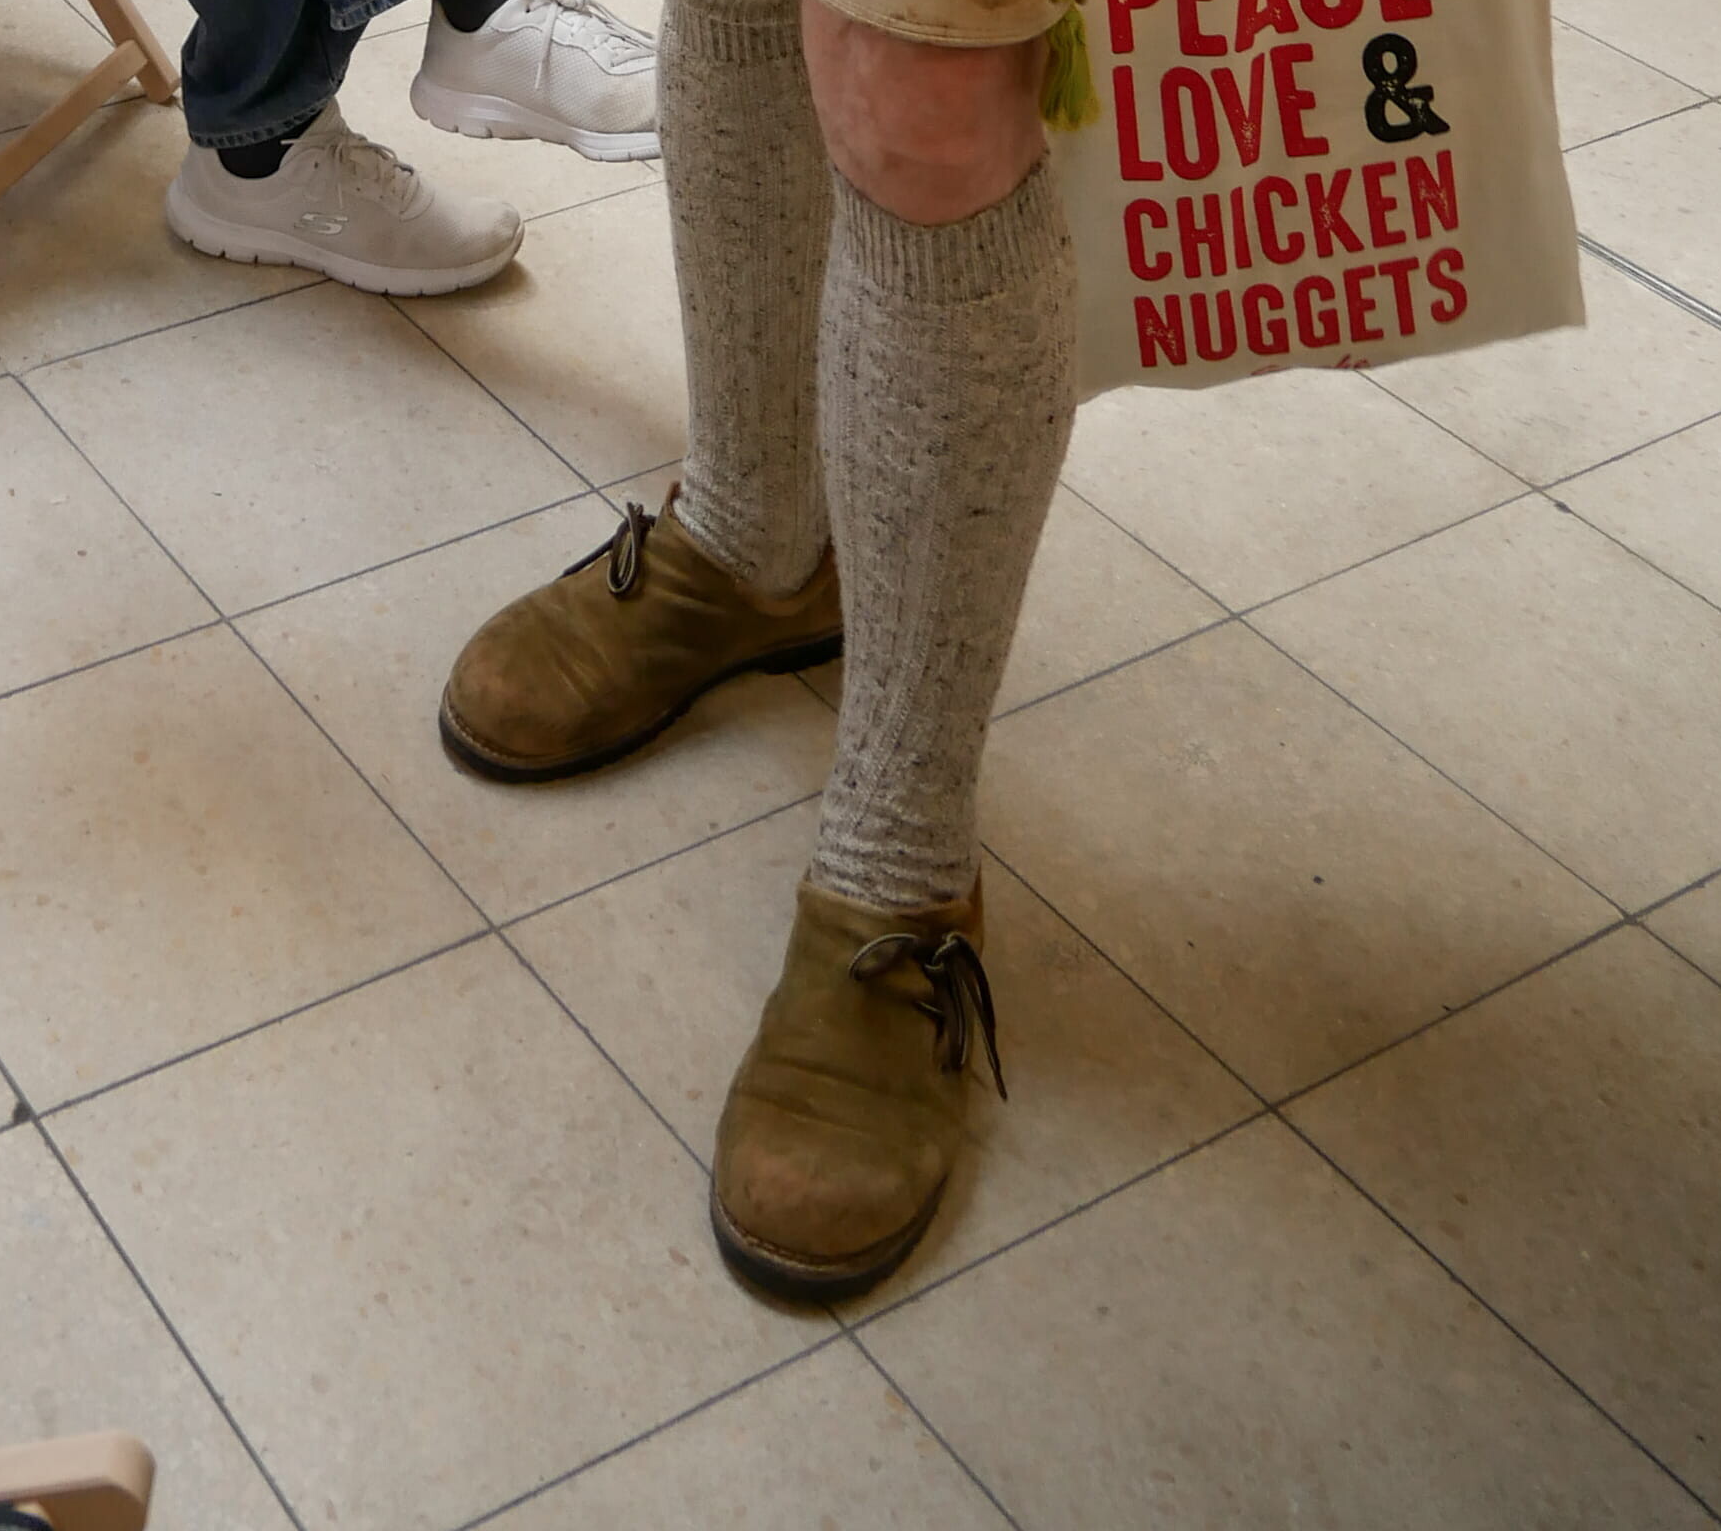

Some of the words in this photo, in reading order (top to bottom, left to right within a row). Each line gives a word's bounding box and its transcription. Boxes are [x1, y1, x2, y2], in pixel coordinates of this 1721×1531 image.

[1112, 42, 1330, 183] LOVE
[1361, 32, 1451, 145] &
[1123, 149, 1460, 282] CHICKEN
[1133, 248, 1470, 370] NUGGETS
